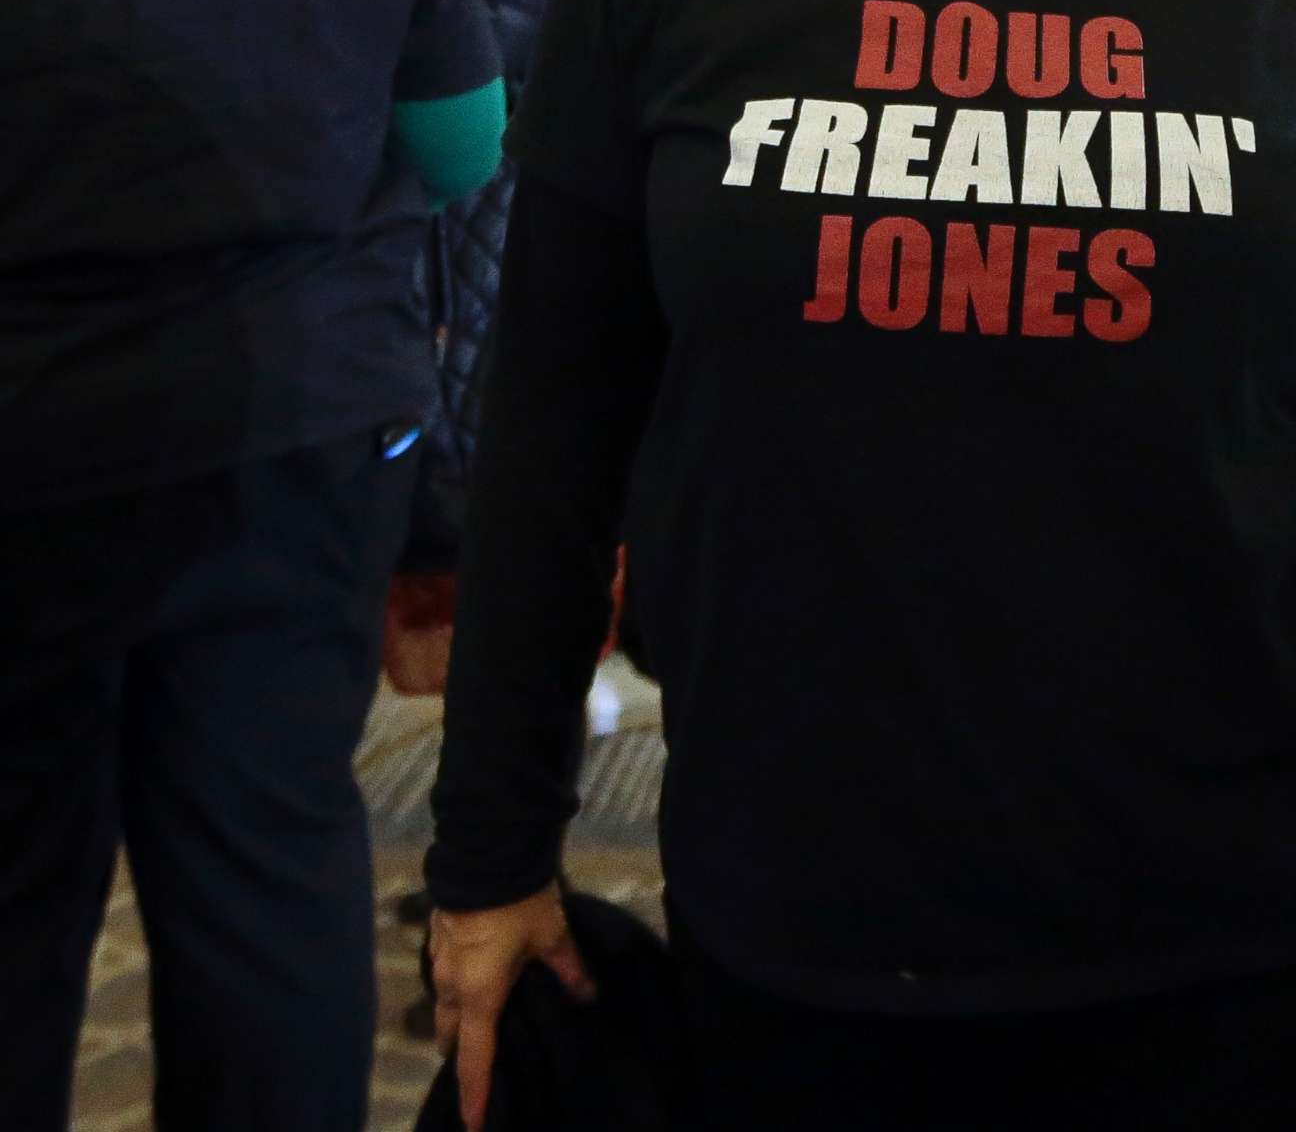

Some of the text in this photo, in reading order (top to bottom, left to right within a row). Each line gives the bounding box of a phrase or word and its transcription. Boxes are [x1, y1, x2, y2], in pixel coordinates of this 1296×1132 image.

[854, 0, 1146, 100] DOUG
[722, 98, 1257, 216] FREAKIN'
[803, 214, 1156, 343] JONES
